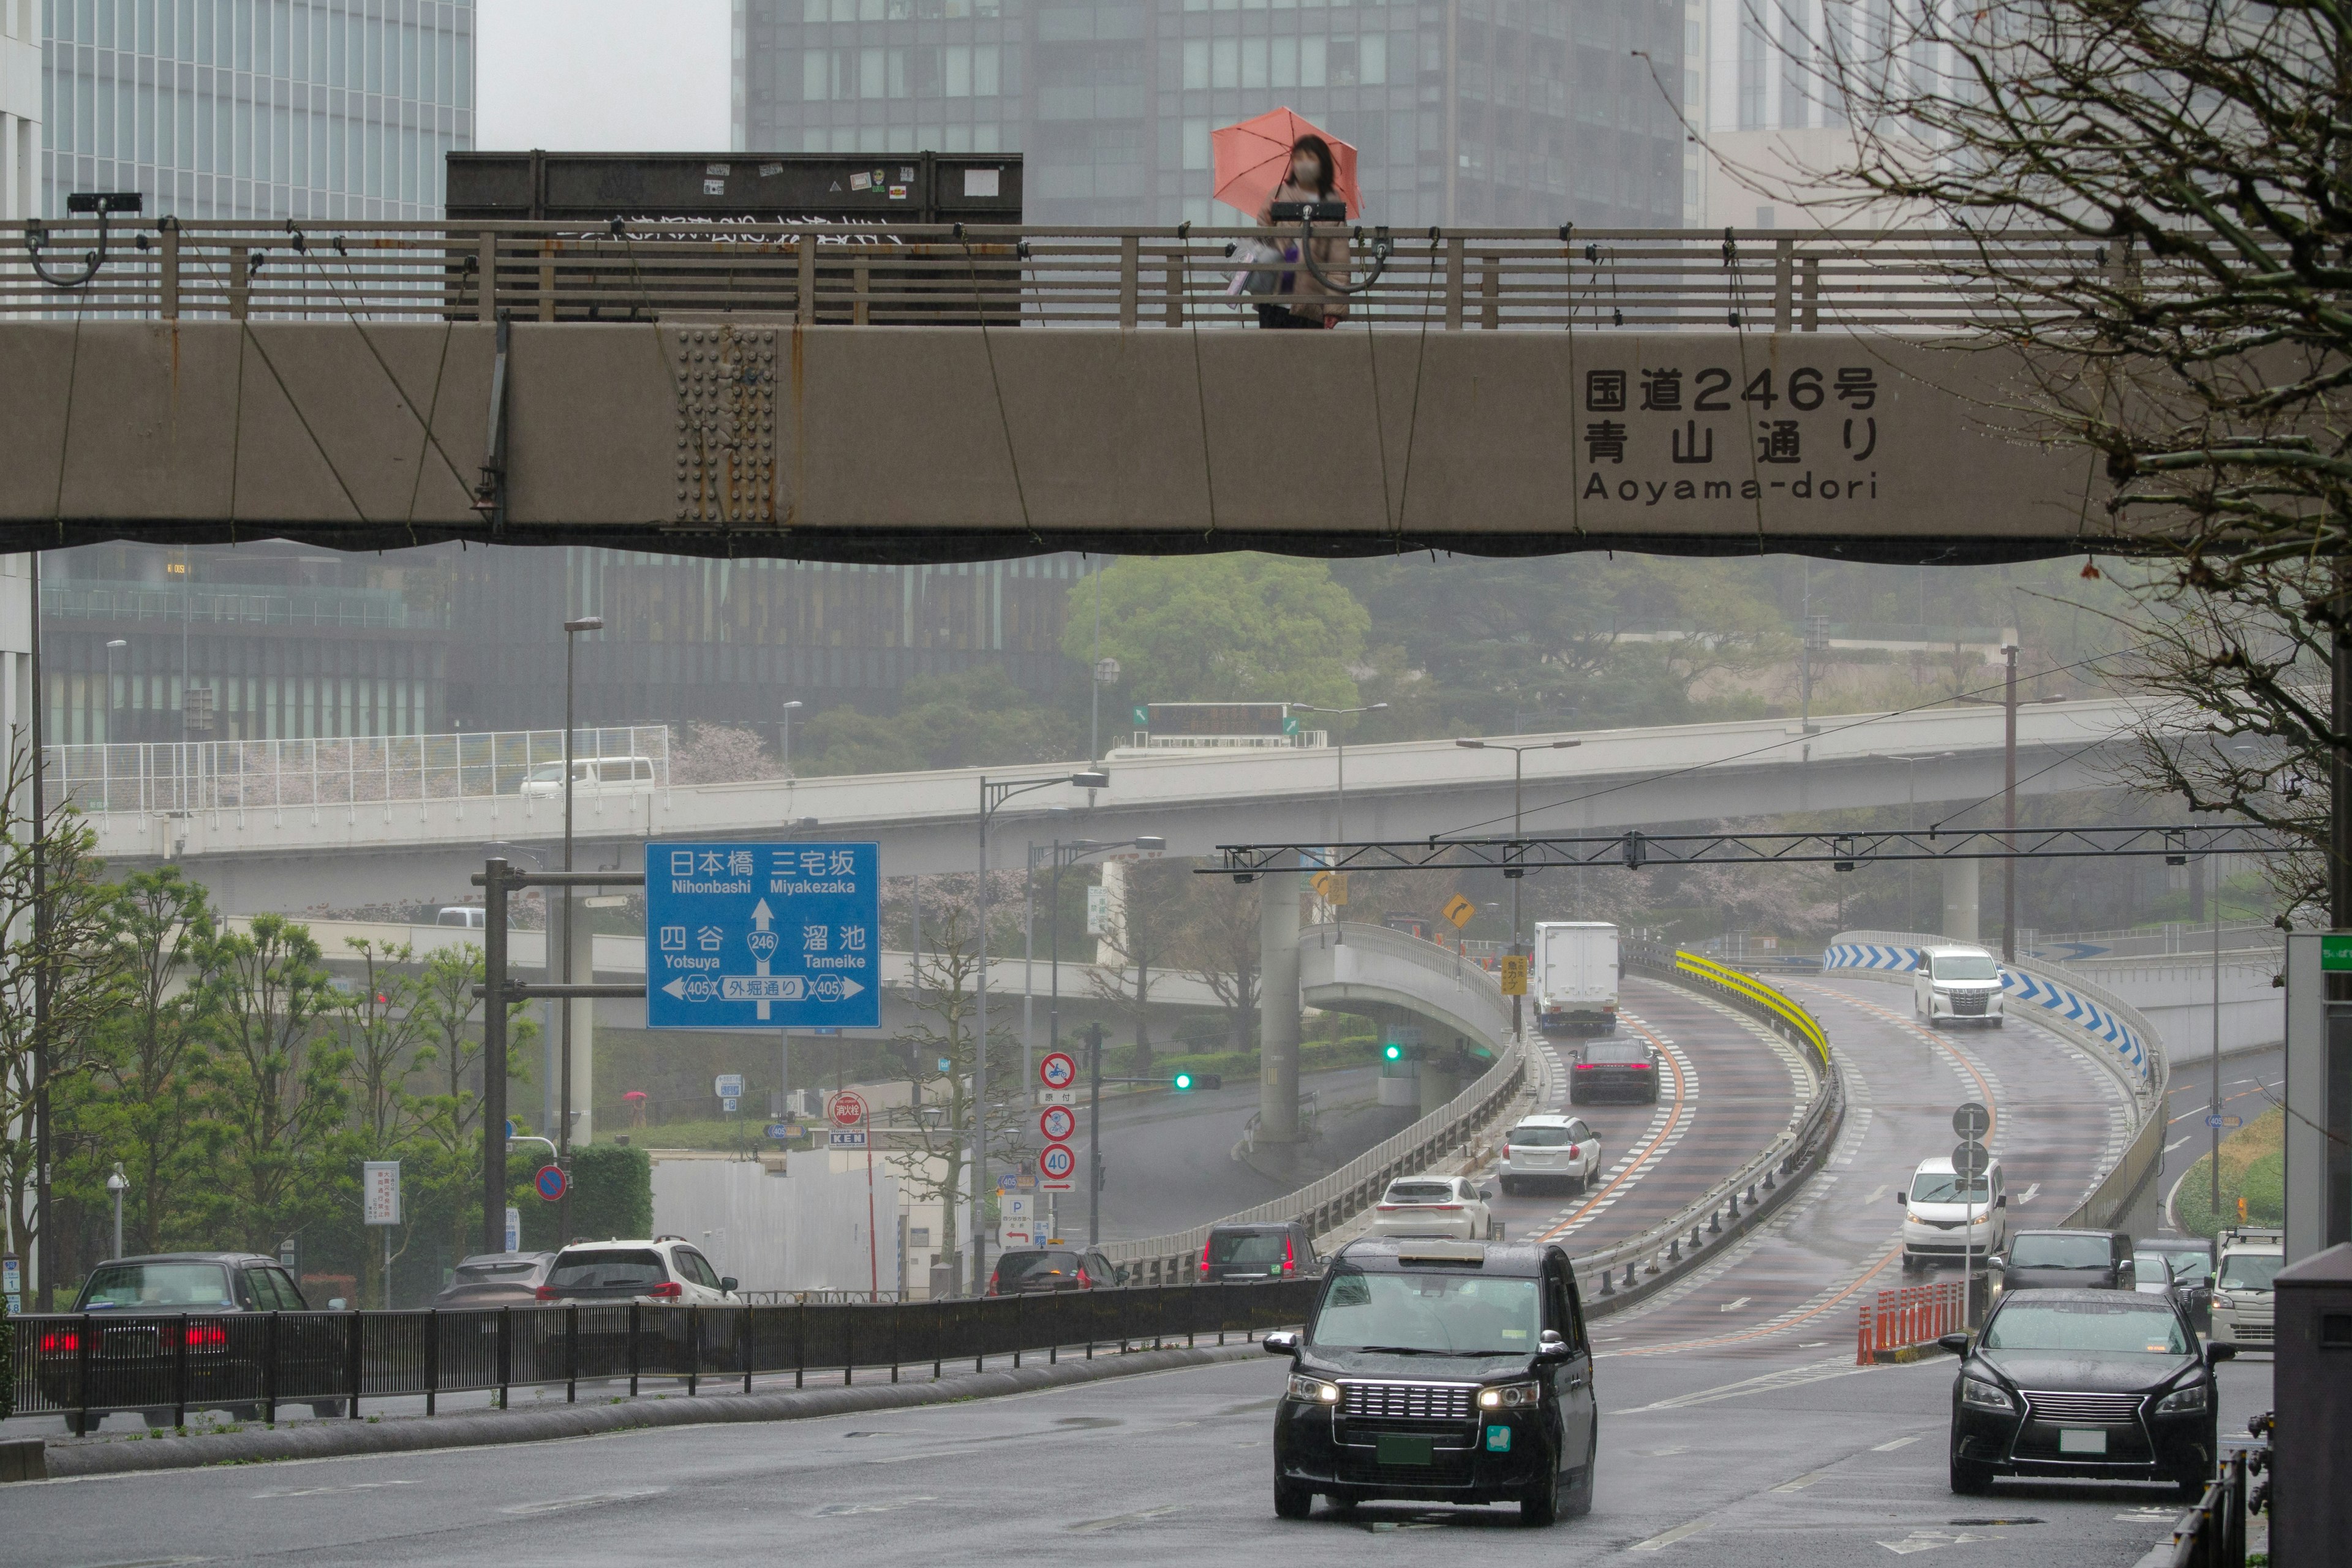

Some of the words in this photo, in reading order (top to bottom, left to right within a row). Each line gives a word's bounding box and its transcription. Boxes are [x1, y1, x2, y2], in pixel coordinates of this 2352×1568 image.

[1585, 366, 1878, 412] 国道246号
[1583, 418, 1877, 464] 青山通り
[1583, 471, 1877, 507] Aoyama-dori
[671, 850, 754, 877] 日本橋
[771, 850, 856, 877] 三宅坂
[672, 880, 751, 894] Nihonbashi
[770, 880, 856, 896] Miyakezaka
[660, 925, 723, 951] 四谷
[751, 934, 774, 950] 246
[803, 925, 866, 951] 溜池
[664, 954, 720, 971] Yotsuya
[804, 954, 866, 969] Tameike
[687, 981, 709, 997] 405
[729, 981, 797, 996] 外堀通り
[816, 981, 839, 997] 405
[1044, 1093, 1071, 1102] 原付
[836, 1104, 860, 1116] 消火栓
[834, 1134, 862, 1143] KEN
[1047, 1153, 1068, 1170] 40
[1003, 1178, 1017, 1186] 405
[1014, 1202, 1022, 1213] P
[9, 1280, 13, 1289] 1
